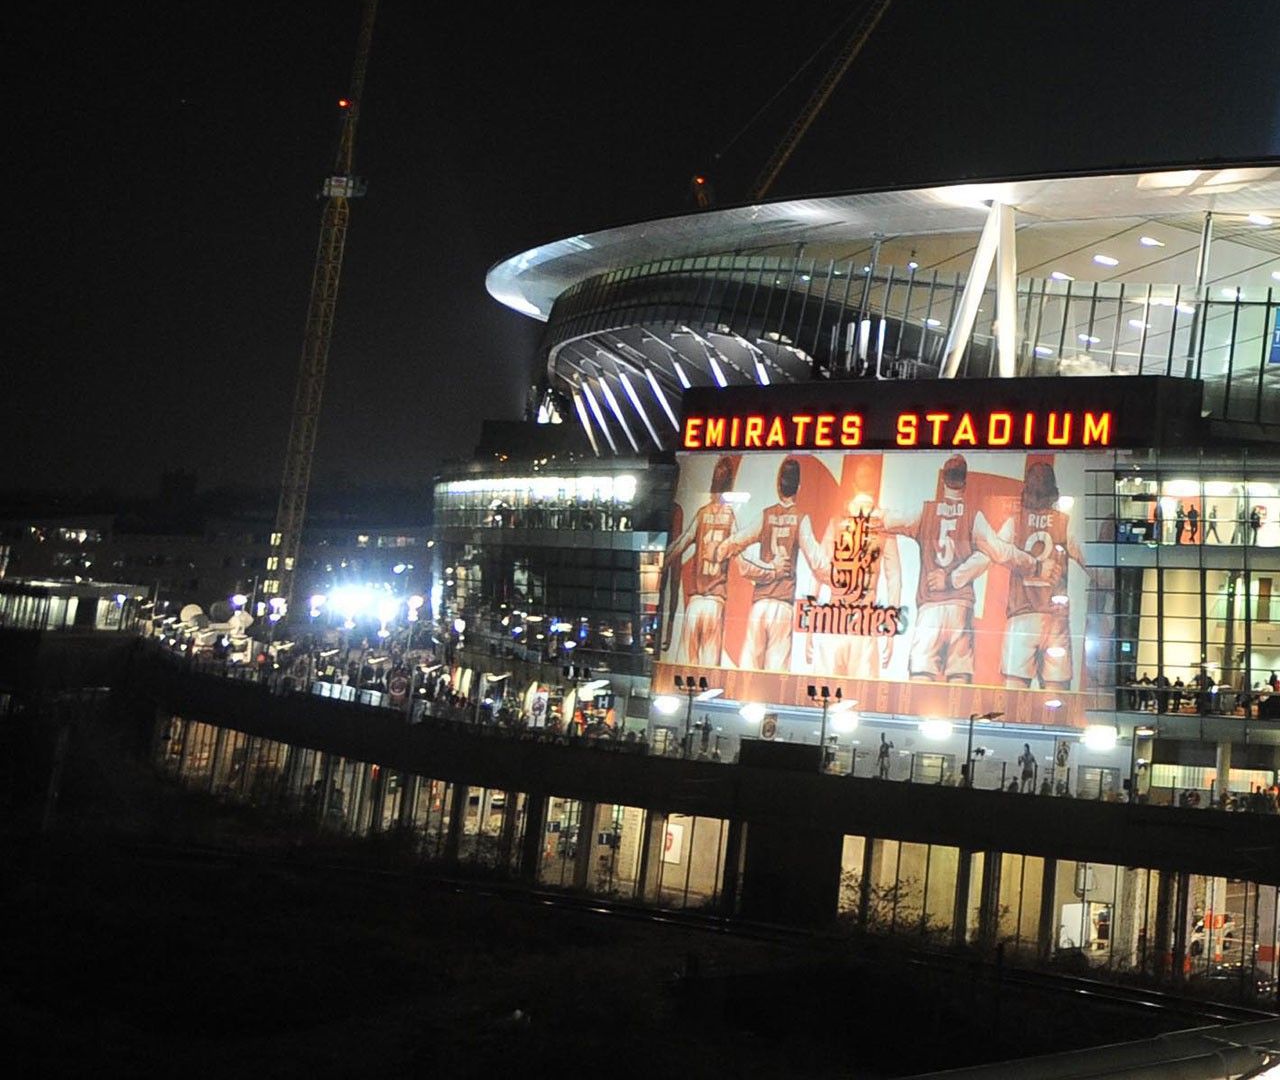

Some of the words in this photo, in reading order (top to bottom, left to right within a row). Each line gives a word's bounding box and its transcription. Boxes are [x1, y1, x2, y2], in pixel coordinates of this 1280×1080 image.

[684, 413, 864, 449] EMIRATES
[896, 411, 1113, 447] STADIUM
[1027, 513, 1054, 529] RICE
[935, 518, 957, 568] 5
[793, 598, 902, 638] Emirates
[598, 697, 609, 708] H
